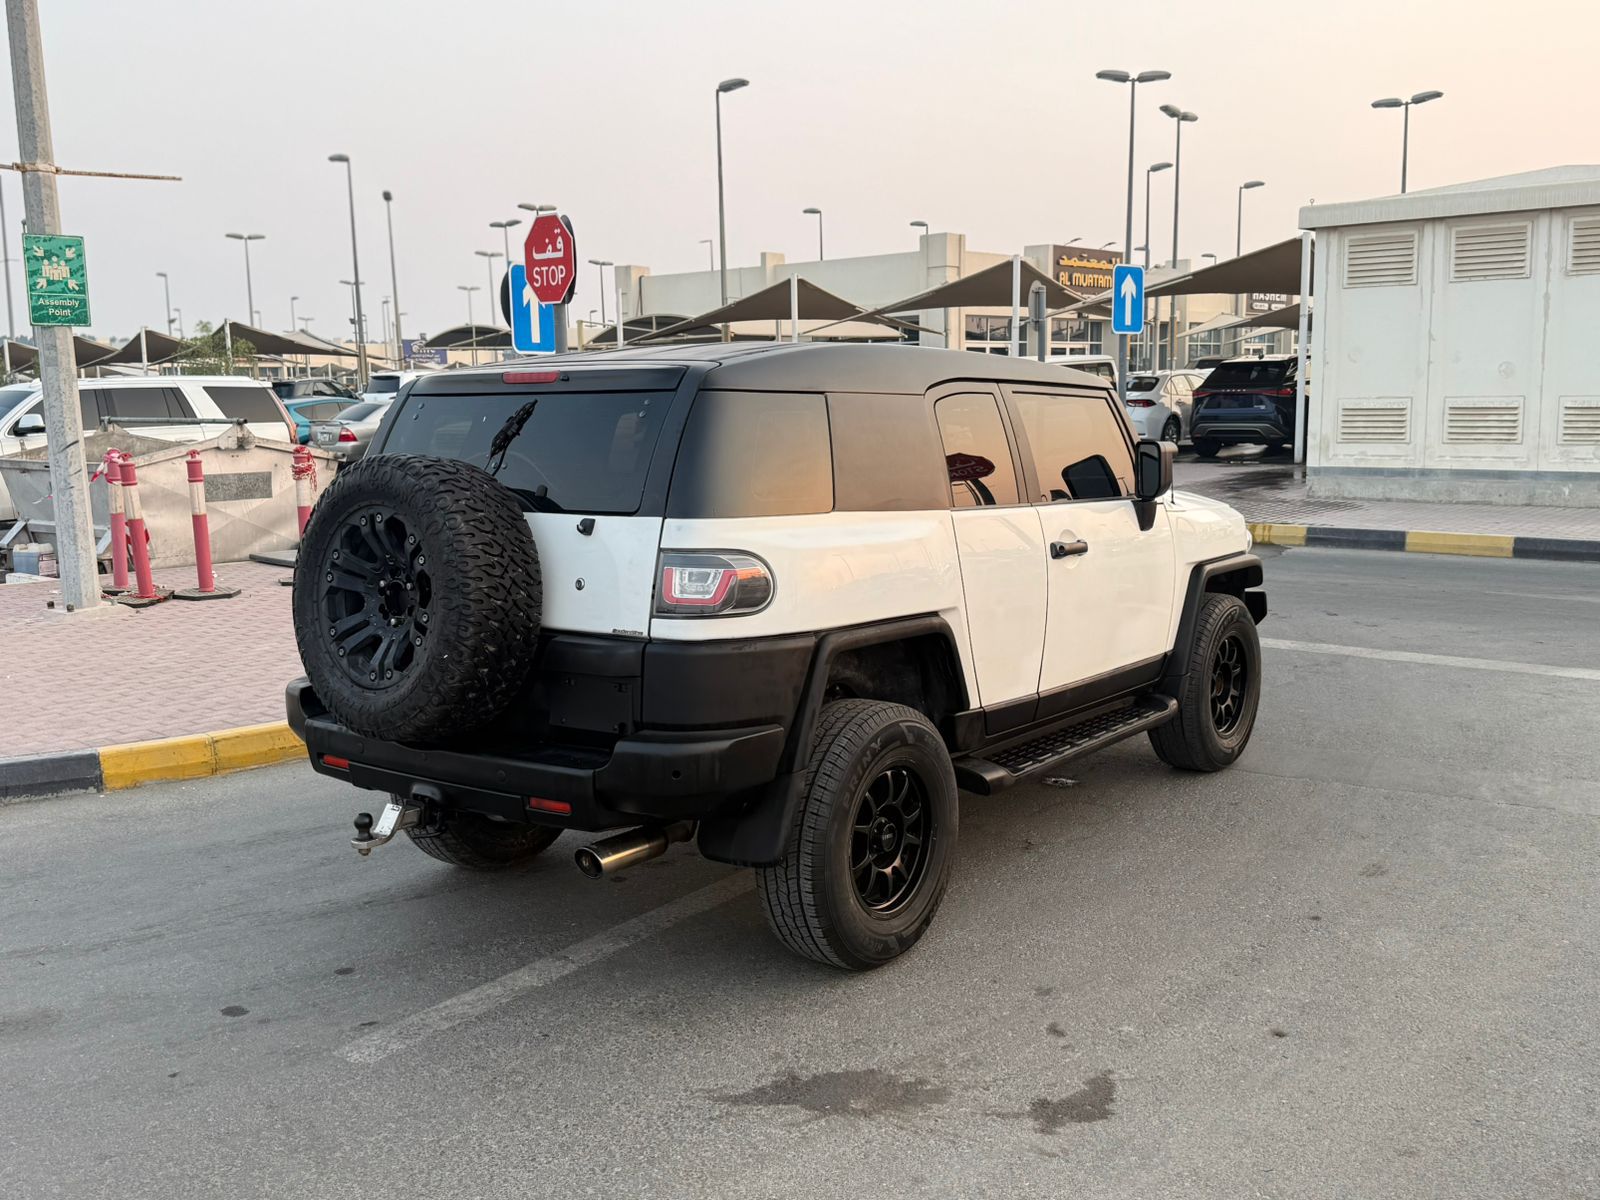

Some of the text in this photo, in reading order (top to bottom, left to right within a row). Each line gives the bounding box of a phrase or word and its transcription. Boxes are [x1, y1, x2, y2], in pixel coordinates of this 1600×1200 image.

[532, 228, 564, 260] قف
[533, 265, 566, 287] STOP
[1060, 271, 1112, 289] AL MUATAM
[38, 297, 80, 308] Assembly
[48, 308, 72, 317] Point
